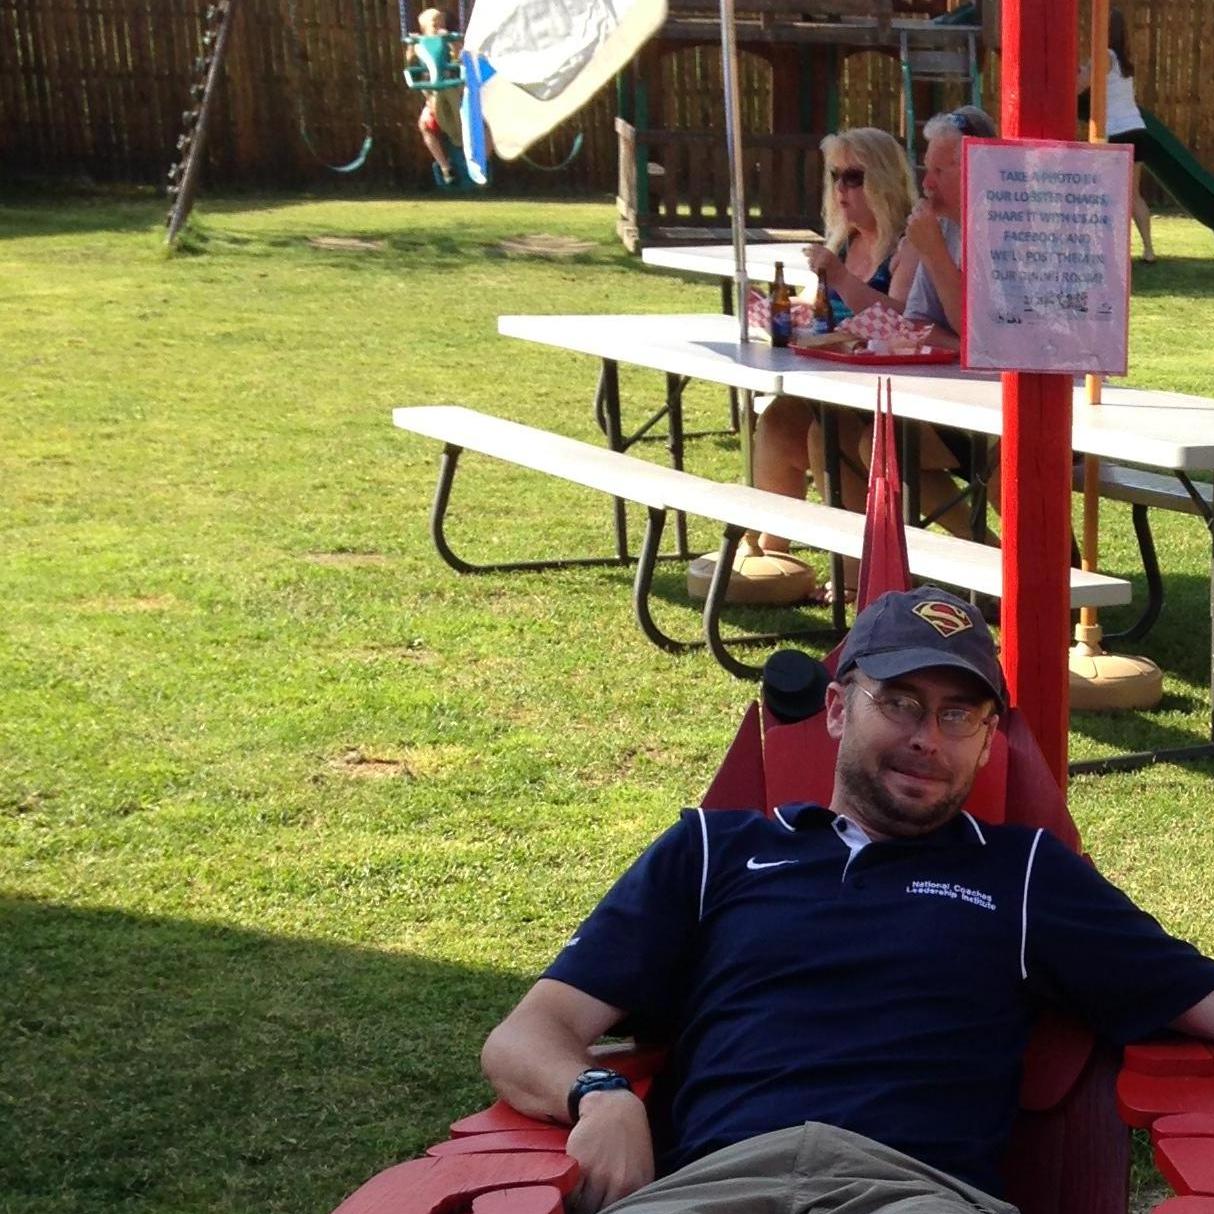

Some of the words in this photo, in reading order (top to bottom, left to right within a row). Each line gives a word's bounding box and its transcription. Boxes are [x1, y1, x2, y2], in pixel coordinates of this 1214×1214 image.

[1000, 171, 1027, 182] TAKE
[986, 190, 1011, 202] OUR
[987, 211, 1023, 222] SHARE
[912, 881, 950, 889] National
[953, 884, 992, 902] Coaches
[906, 886, 958, 899] Leadership
[961, 893, 996, 911] Institute
